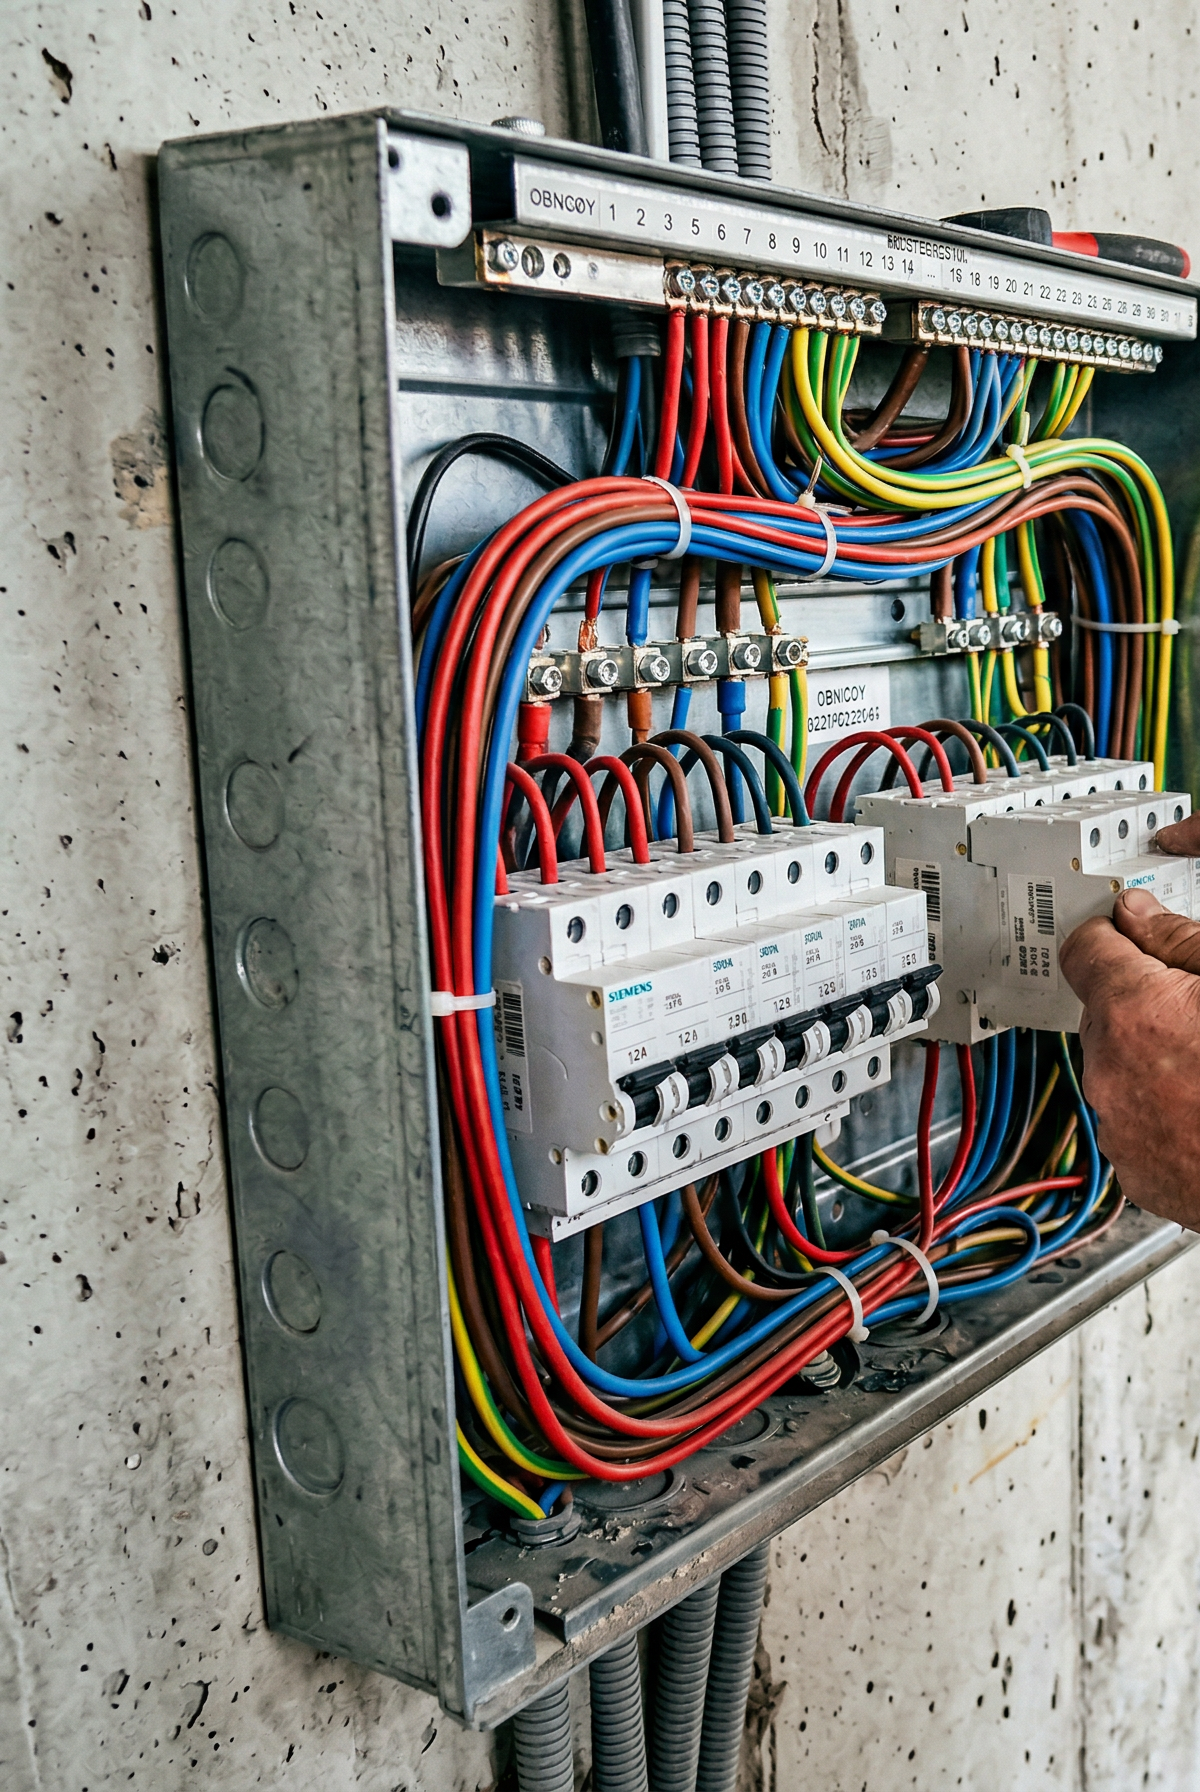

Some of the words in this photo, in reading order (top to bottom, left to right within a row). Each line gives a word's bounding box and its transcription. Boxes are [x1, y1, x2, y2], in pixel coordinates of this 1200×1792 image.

[609, 204, 616, 221] 1
[637, 208, 646, 227] 2
[664, 213, 673, 231] 3
[691, 218, 701, 236] 5
[717, 223, 727, 241] 6
[743, 228, 752, 245] 7
[768, 233, 777, 250] 8
[792, 237, 801, 254] 9
[813, 241, 827, 259] 10
[837, 246, 849, 263] 11
[859, 251, 873, 268] 12
[882, 255, 894, 271] 13
[902, 258, 914, 275] 14
[970, 272, 981, 287] 18
[989, 275, 999, 290] 19
[1006, 279, 1017, 293] 20
[1024, 282, 1034, 296] 21
[1040, 285, 1051, 300] 22
[817, 685, 866, 706] OBNICOY
[608, 981, 653, 1003] SIEMENS
[678, 1029, 698, 1047] 12A
[628, 1046, 648, 1065] 12A
